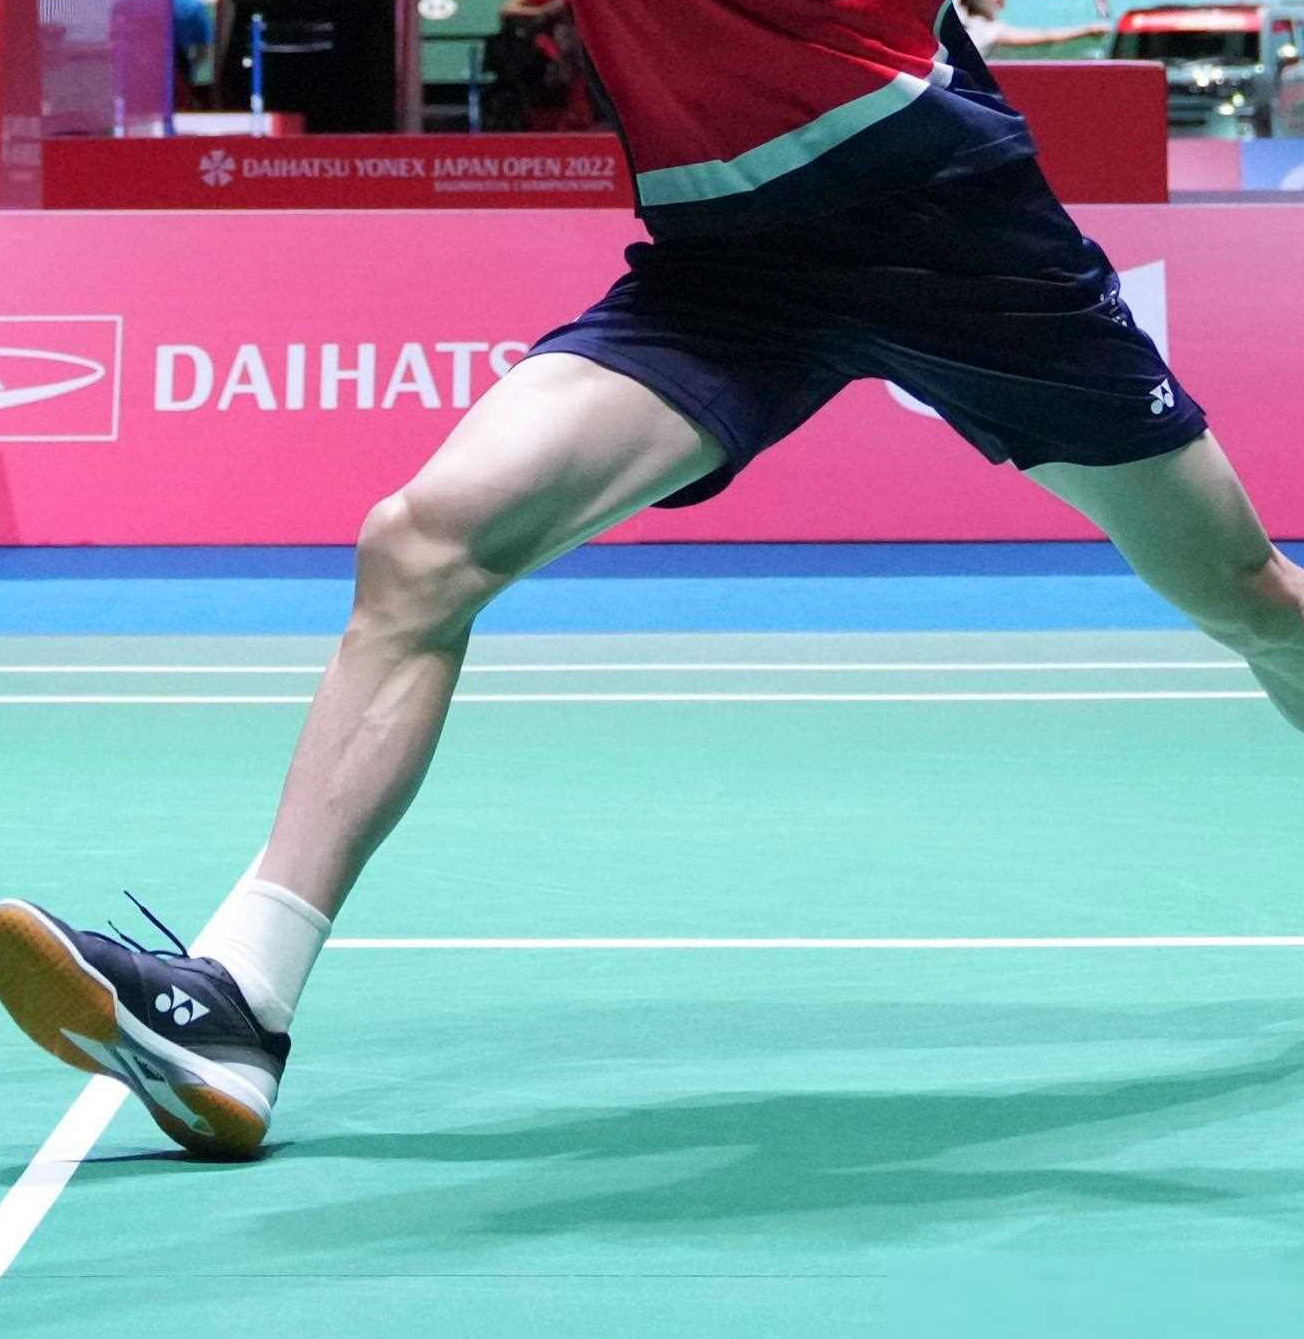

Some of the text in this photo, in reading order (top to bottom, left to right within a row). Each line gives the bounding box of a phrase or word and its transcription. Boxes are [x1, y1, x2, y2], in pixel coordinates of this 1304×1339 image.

[242, 157, 615, 178] DAIHATSU YONEX JAPAN OPEN 2022
[154, 342, 531, 411] DAIHATS
